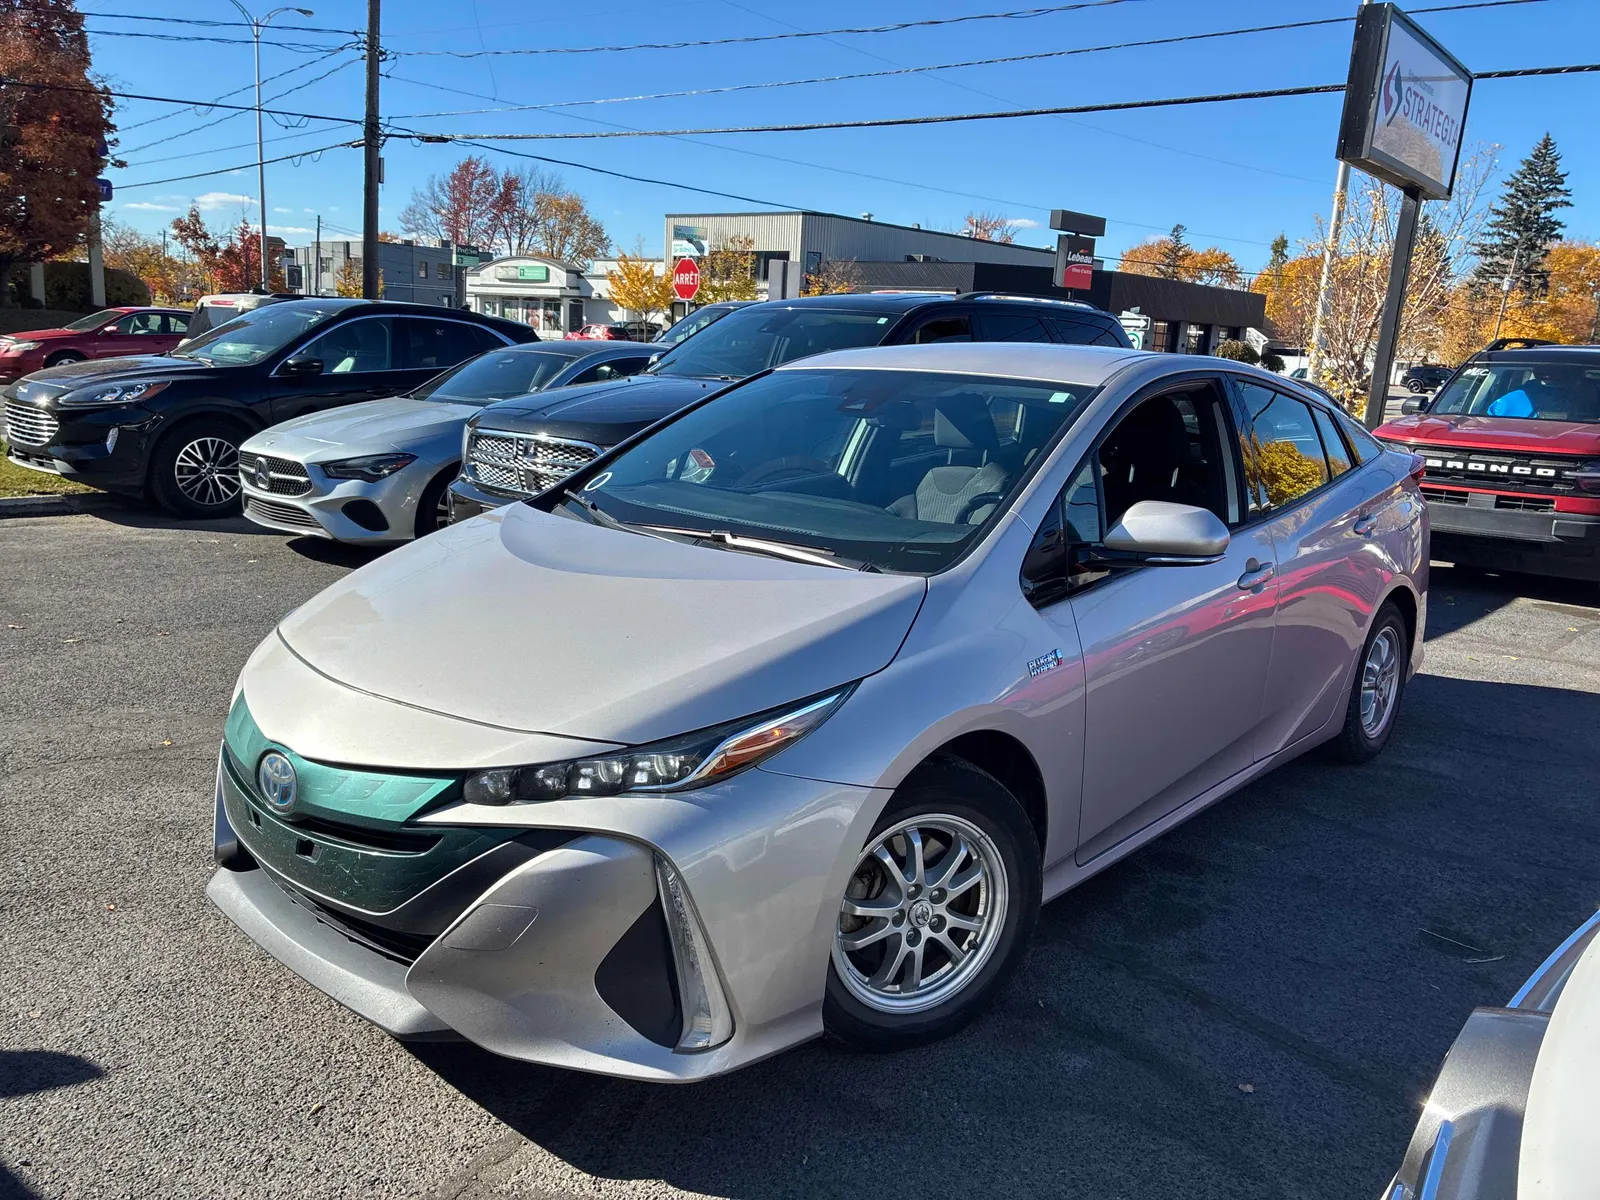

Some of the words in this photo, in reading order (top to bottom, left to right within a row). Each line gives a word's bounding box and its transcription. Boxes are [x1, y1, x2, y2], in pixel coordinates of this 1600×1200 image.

[1403, 86, 1459, 149] STRATEGIA
[674, 231, 705, 240] Brousseau
[1067, 251, 1093, 264] Lebeau
[675, 270, 698, 286] ARRÊT
[1426, 459, 1556, 477] BRONCO
